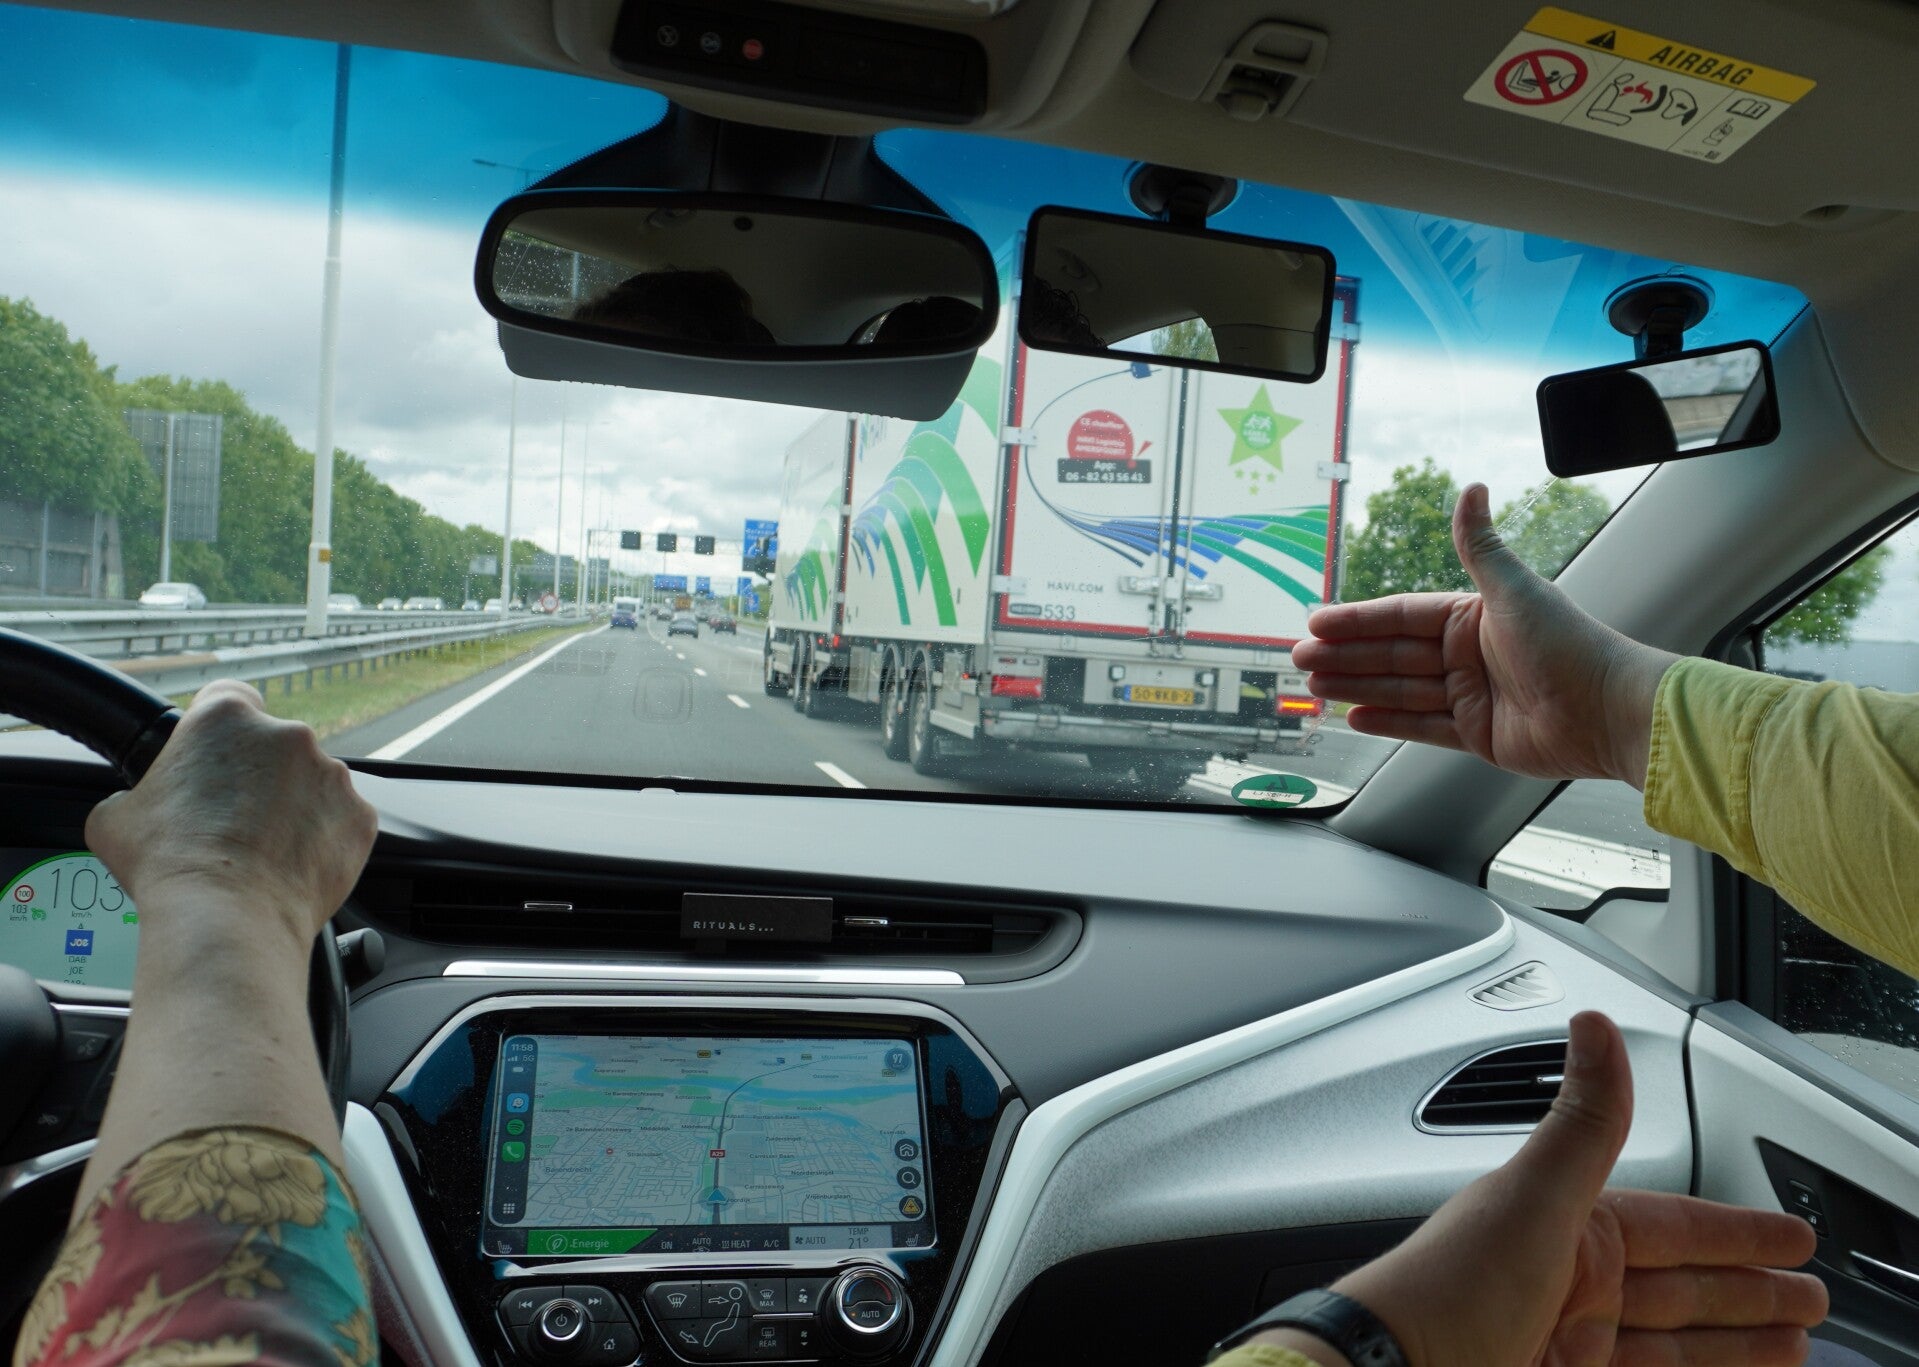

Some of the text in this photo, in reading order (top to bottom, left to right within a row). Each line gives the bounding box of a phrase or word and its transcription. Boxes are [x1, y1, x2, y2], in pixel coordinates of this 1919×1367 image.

[1649, 45, 1753, 85] AIRBAG
[1046, 581, 1104, 593] HAVI.COM
[1043, 604, 1076, 621] 533
[18, 890, 31, 898] 100
[51, 867, 125, 912] 103
[11, 904, 28, 914] 103
[71, 910, 92, 918] km/h
[69, 938, 89, 947] JOE
[68, 956, 87, 964] DAB
[68, 966, 84, 975] JOE
[510, 1043, 534, 1052] 11:58
[892, 1053, 903, 1064] 97
[572, 1239, 610, 1250] Energie
[692, 1237, 712, 1245] AUTO
[731, 1240, 751, 1248] HEAT
[763, 1240, 780, 1248] A/C
[804, 1236, 826, 1245] AUTO
[661, 1241, 673, 1250] ON
